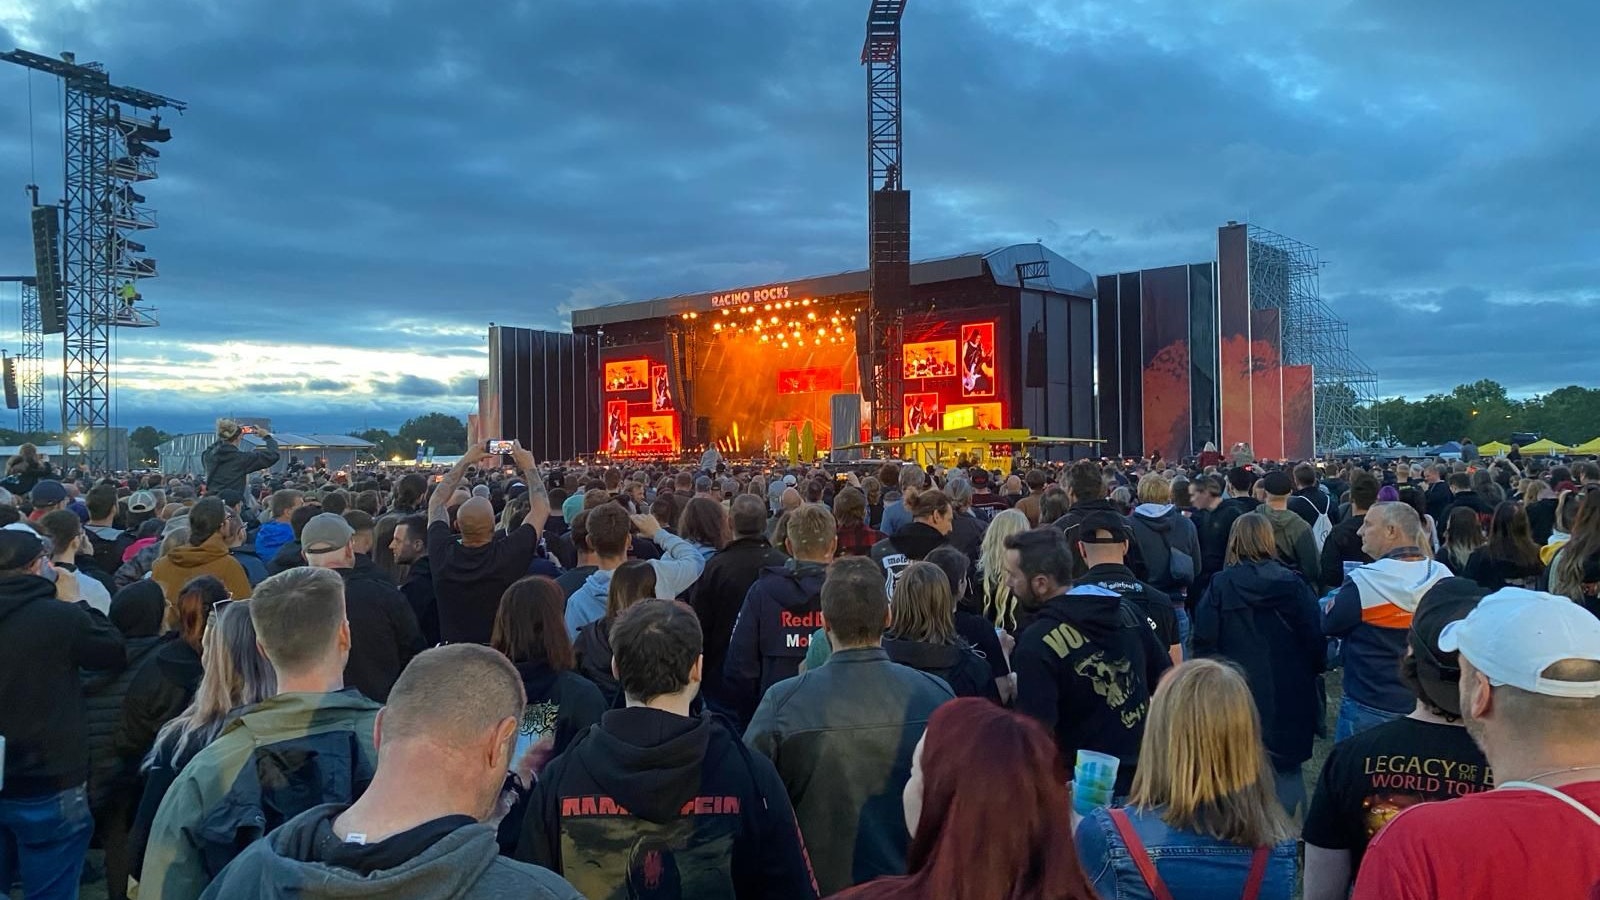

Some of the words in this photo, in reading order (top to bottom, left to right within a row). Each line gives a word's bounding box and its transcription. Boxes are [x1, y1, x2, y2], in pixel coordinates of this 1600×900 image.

[711, 291, 750, 307] RACINO
[753, 286, 789, 302] ROCKS
[781, 611, 813, 627] Red
[1364, 755, 1456, 778] LEGACY
[1458, 763, 1478, 774] OF
[1372, 774, 1440, 792] WORLD
